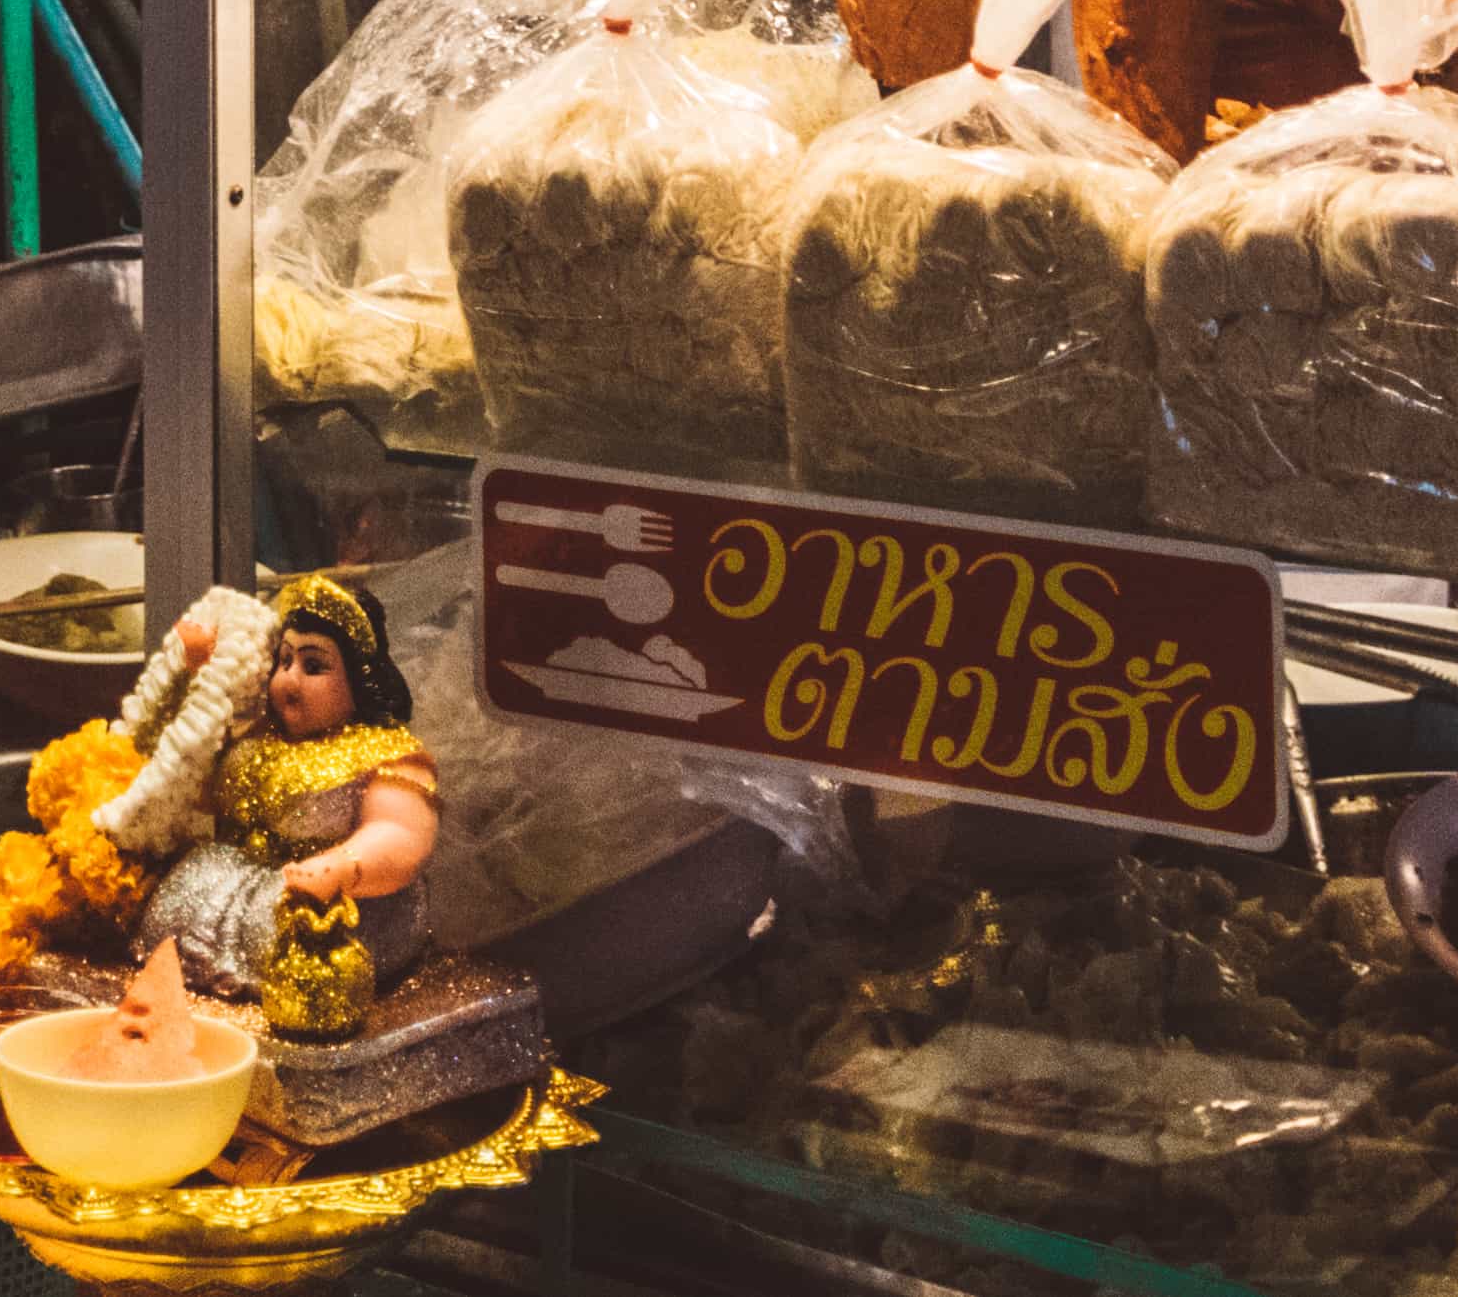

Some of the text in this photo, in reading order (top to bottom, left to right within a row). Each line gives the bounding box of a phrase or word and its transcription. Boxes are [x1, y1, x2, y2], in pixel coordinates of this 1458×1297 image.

[704, 518, 1121, 669] อาหาร
[763, 640, 1257, 812] ตามสั่ง
